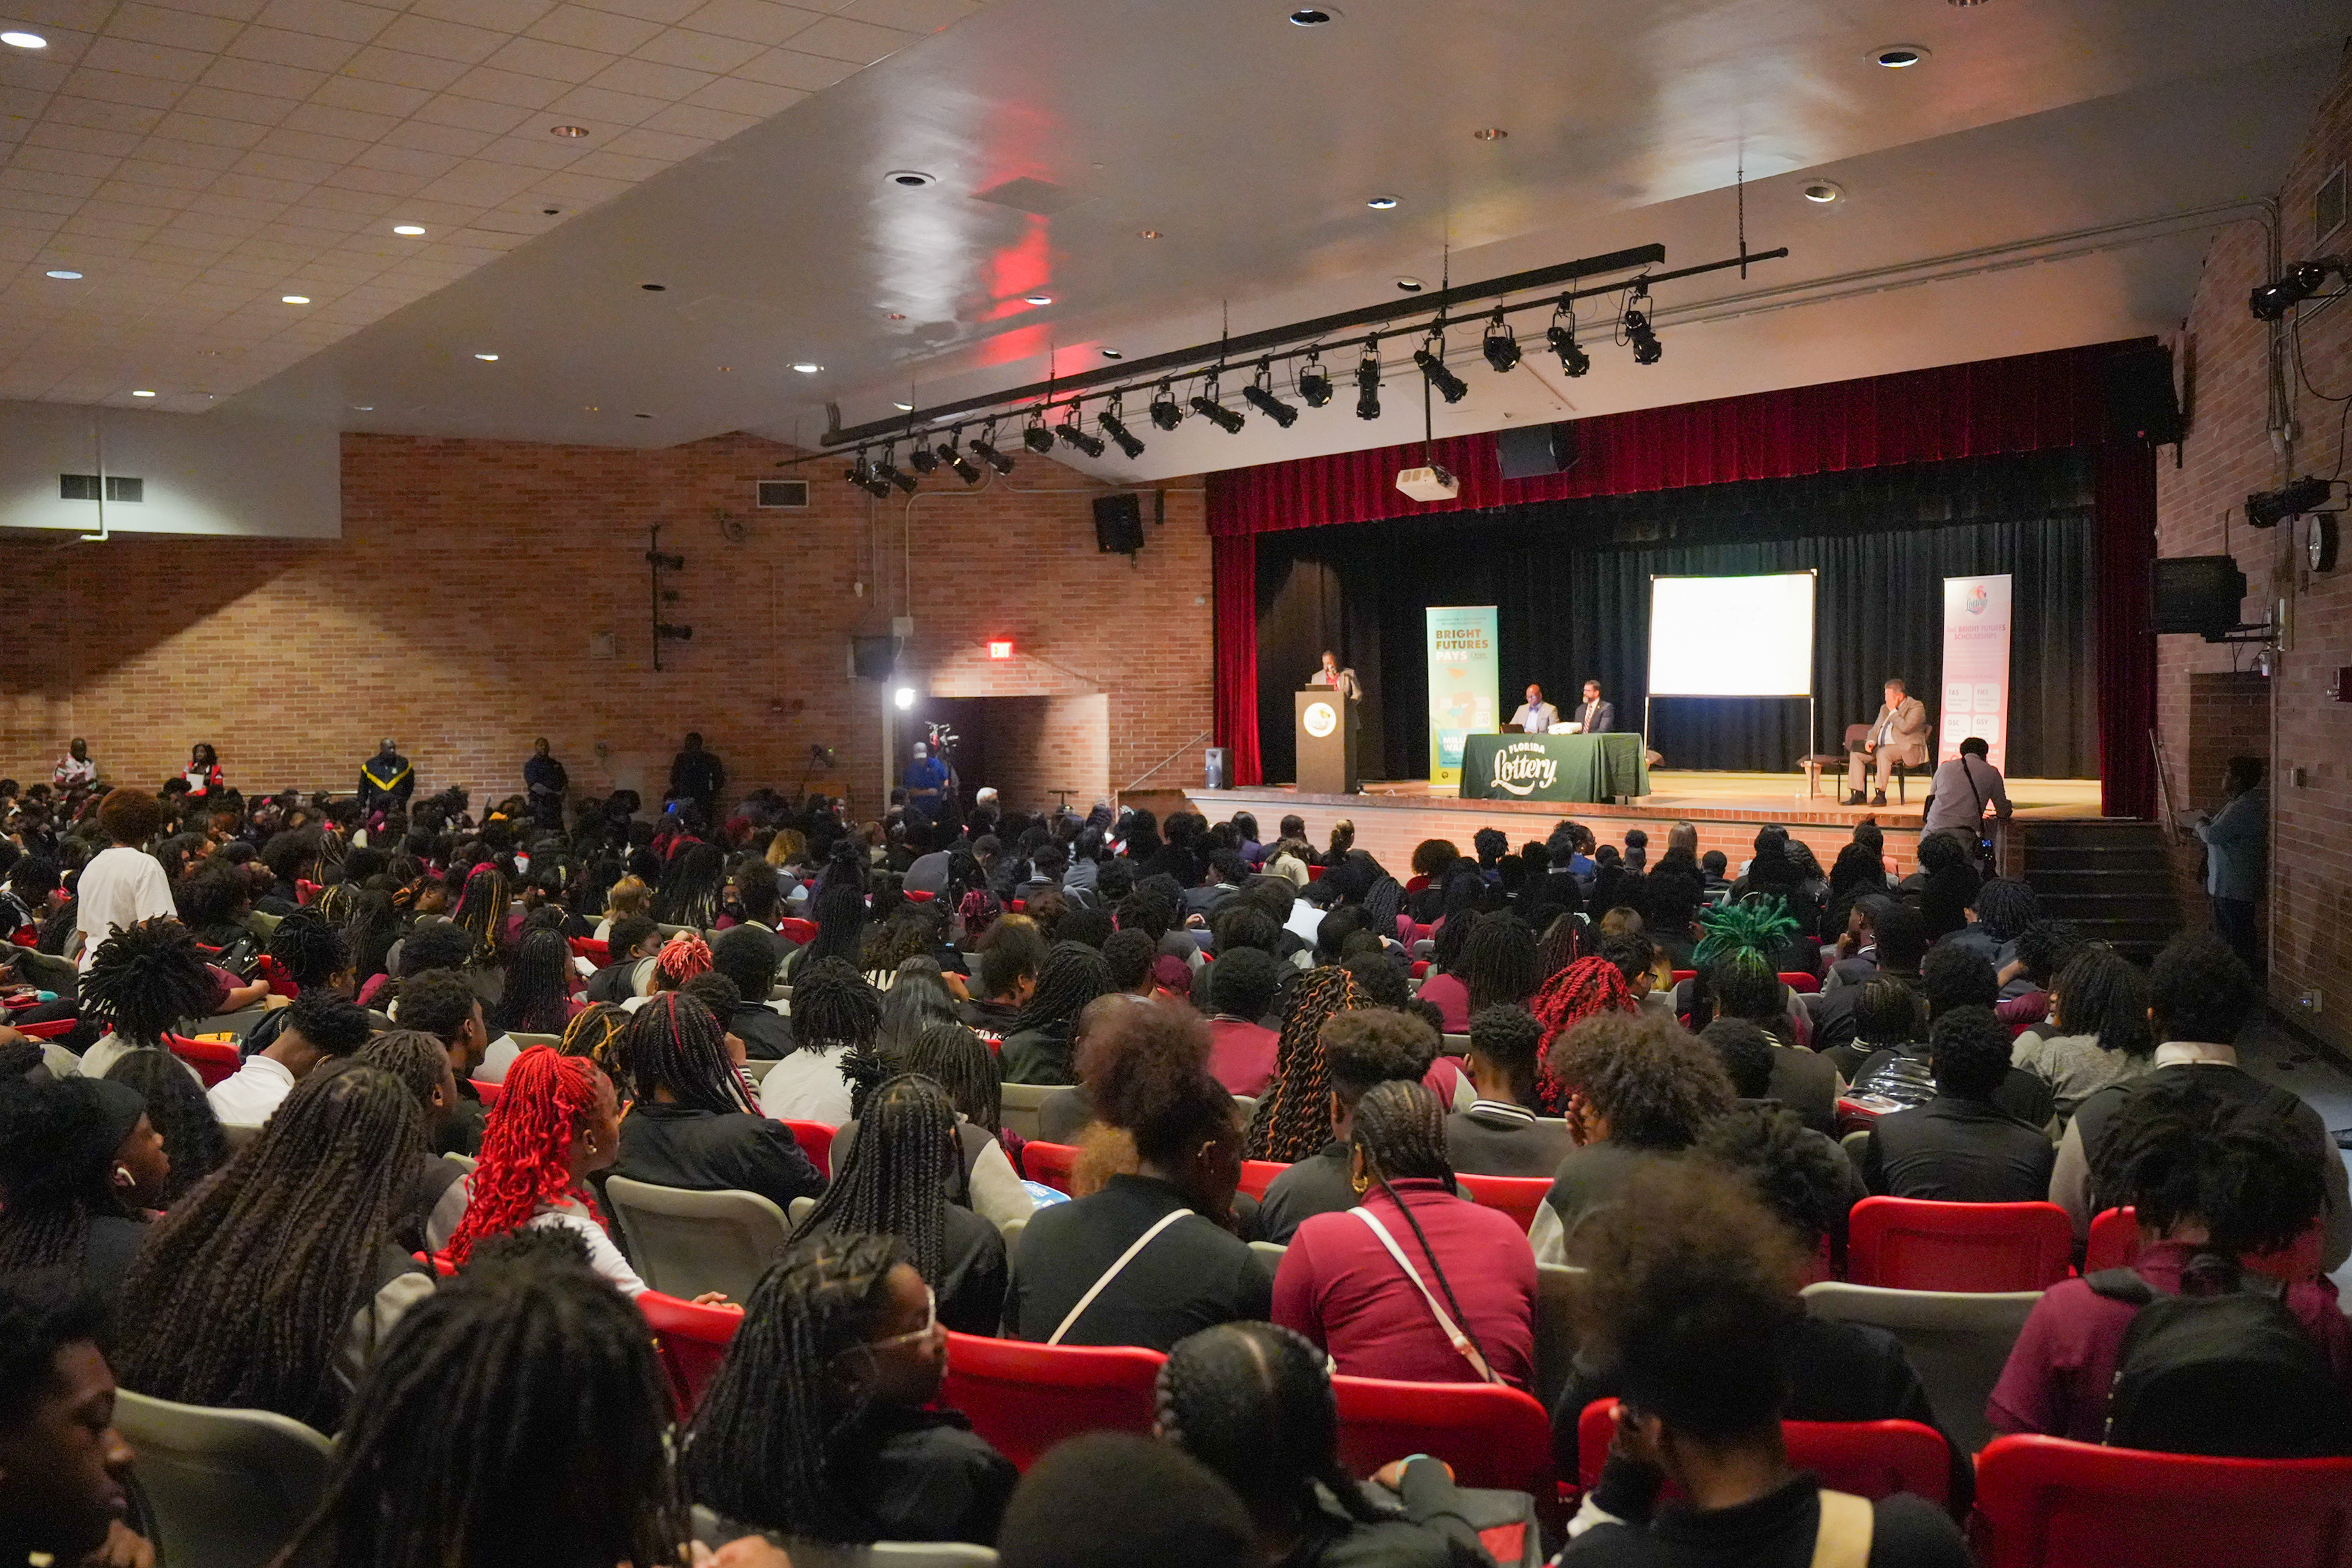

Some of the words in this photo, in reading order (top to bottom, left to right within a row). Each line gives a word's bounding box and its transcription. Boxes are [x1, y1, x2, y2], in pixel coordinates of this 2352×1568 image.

[1436, 629, 1481, 639] BRIGHT
[1436, 639, 1489, 650] FUTURES
[1436, 650, 1468, 662] PAYS
[1508, 742, 1545, 754] FLORIDA
[1490, 749, 1558, 796] Lottery
